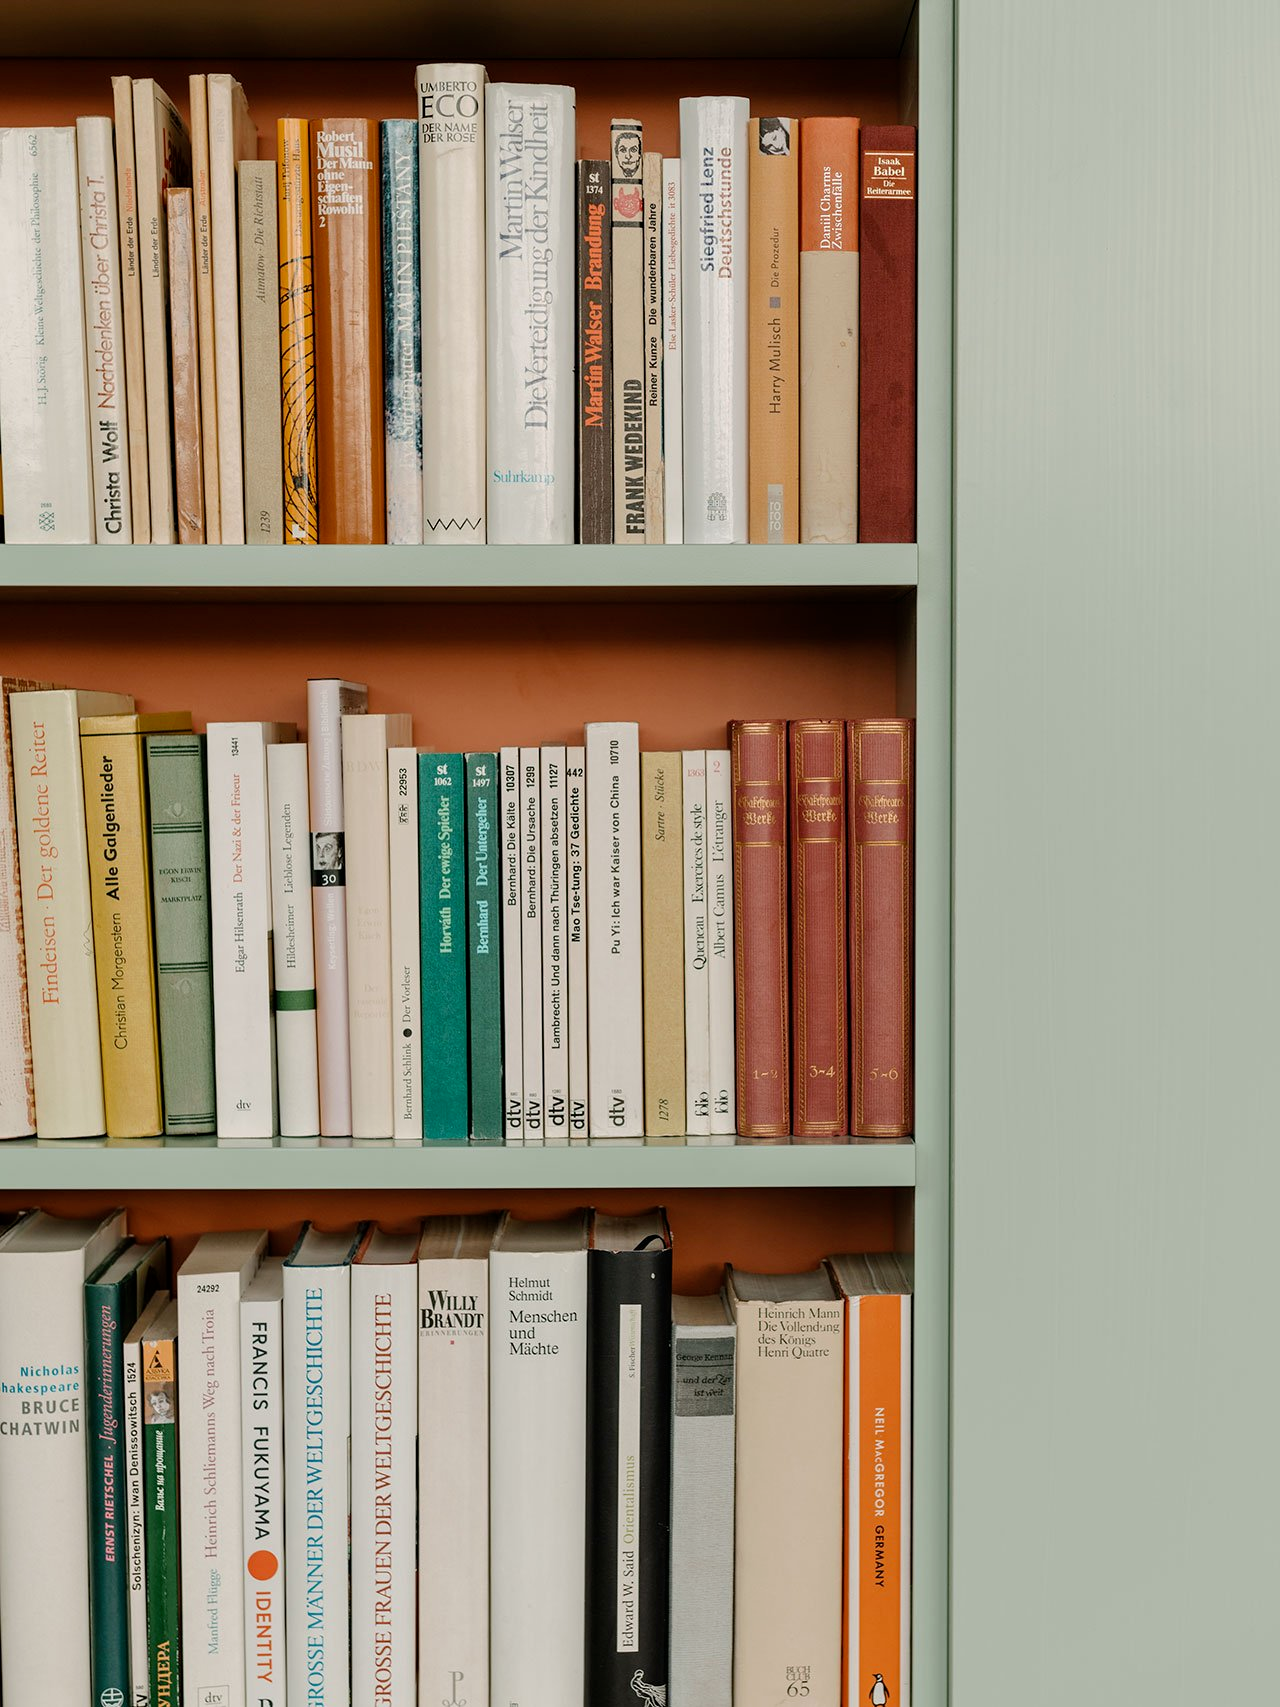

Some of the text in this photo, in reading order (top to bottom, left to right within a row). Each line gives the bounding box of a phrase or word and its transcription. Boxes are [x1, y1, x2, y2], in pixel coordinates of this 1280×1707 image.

[420, 82, 477, 93] UMBERTO
[421, 95, 479, 119] ECO
[26, 134, 38, 157] 6562
[317, 131, 355, 143] Robert
[422, 123, 477, 133] DER NAME
[423, 133, 476, 143] DER ROSE
[317, 142, 363, 158] Musil
[317, 159, 373, 170] Der Mann
[318, 170, 345, 181] ohne
[499, 99, 524, 260] Martin Walser
[667, 182, 677, 201] 3083
[820, 166, 831, 211] Charms
[26, 172, 42, 226] Philosophie
[699, 147, 718, 271] Siegfried Lenz
[717, 147, 732, 278] Deutschstunde
[832, 172, 842, 249] Zwischenfälle
[31, 229, 41, 244] der
[126, 217, 134, 234] Erde
[668, 213, 678, 270] Liebesgedichte
[31, 247, 46, 315] Weltgeschichte
[524, 103, 553, 430] Die Verteidigung der Kindheit
[582, 203, 606, 425] Martin Walser Brandung
[648, 203, 657, 406] Reiner Kunze Die wunderbaren Jahre
[767, 228, 785, 413] Harry Mulisch Die Prozedur
[33, 316, 45, 345] Kleine
[669, 334, 678, 350] Else
[86, 176, 122, 534] Christa Wolf Nachdenken über Christa T.
[623, 379, 645, 534] FRANK WEDEKIND
[399, 768, 407, 796] 22953
[506, 765, 516, 906] Bernhard: Die Kälte 10307
[610, 740, 620, 954] Pu Yi: Ich war Kaiser von China 10710
[30, 721, 59, 1004] Findeisen Der goldene Reiter
[99, 756, 128, 1050] Christian Morgenstern Alle Galgenlieder
[281, 804, 296, 968] Hildesheimer Lieblose Legenden
[713, 874, 725, 917] Camus
[549, 764, 561, 1049] Lambrecht: Und dann nach Thüringen absetzen 11127
[713, 922, 725, 958] Albert
[401, 966, 412, 1119] Bernhard Schlink Der Vorleser
[509, 1277, 550, 1288] Helmut
[509, 1290, 553, 1301] Schmidt
[510, 1310, 577, 1323] Menschen
[758, 1308, 840, 1319] Heinrich Mann
[759, 1321, 777, 1332] Die
[509, 1327, 535, 1339] und
[510, 1342, 559, 1355] Mächte
[758, 1334, 816, 1346] des Königs
[20, 1365, 79, 1377] Nicholas
[758, 1346, 829, 1359] Henri Quatre
[22, 1398, 79, 1414] BRUCE
[375, 1294, 392, 1490] WELTGESCHICHTE
[0, 1419, 79, 1435] CHATWIN
[98, 1305, 118, 1561] ERNST RIETSCHEL Jugenderinnerungen
[875, 1408, 886, 1435] NEIL
[127, 1362, 142, 1590] Solschenizyn: Iwan Denissowitsch 1524
[157, 1475, 164, 1485] на
[201, 1309, 221, 1654] Manfred Flügge Heinrich Schliemanns Weg nach Troia
[155, 1487, 165, 1511] Вальс
[252, 1322, 272, 1683] FRANCIS FUKUYAMA IDENTITY
[375, 1494, 391, 1535] DER
[622, 1455, 635, 1646] Edward W. Said Orientalismus
[875, 1525, 884, 1587] GERMANY
[375, 1541, 391, 1625] FRAUEN
